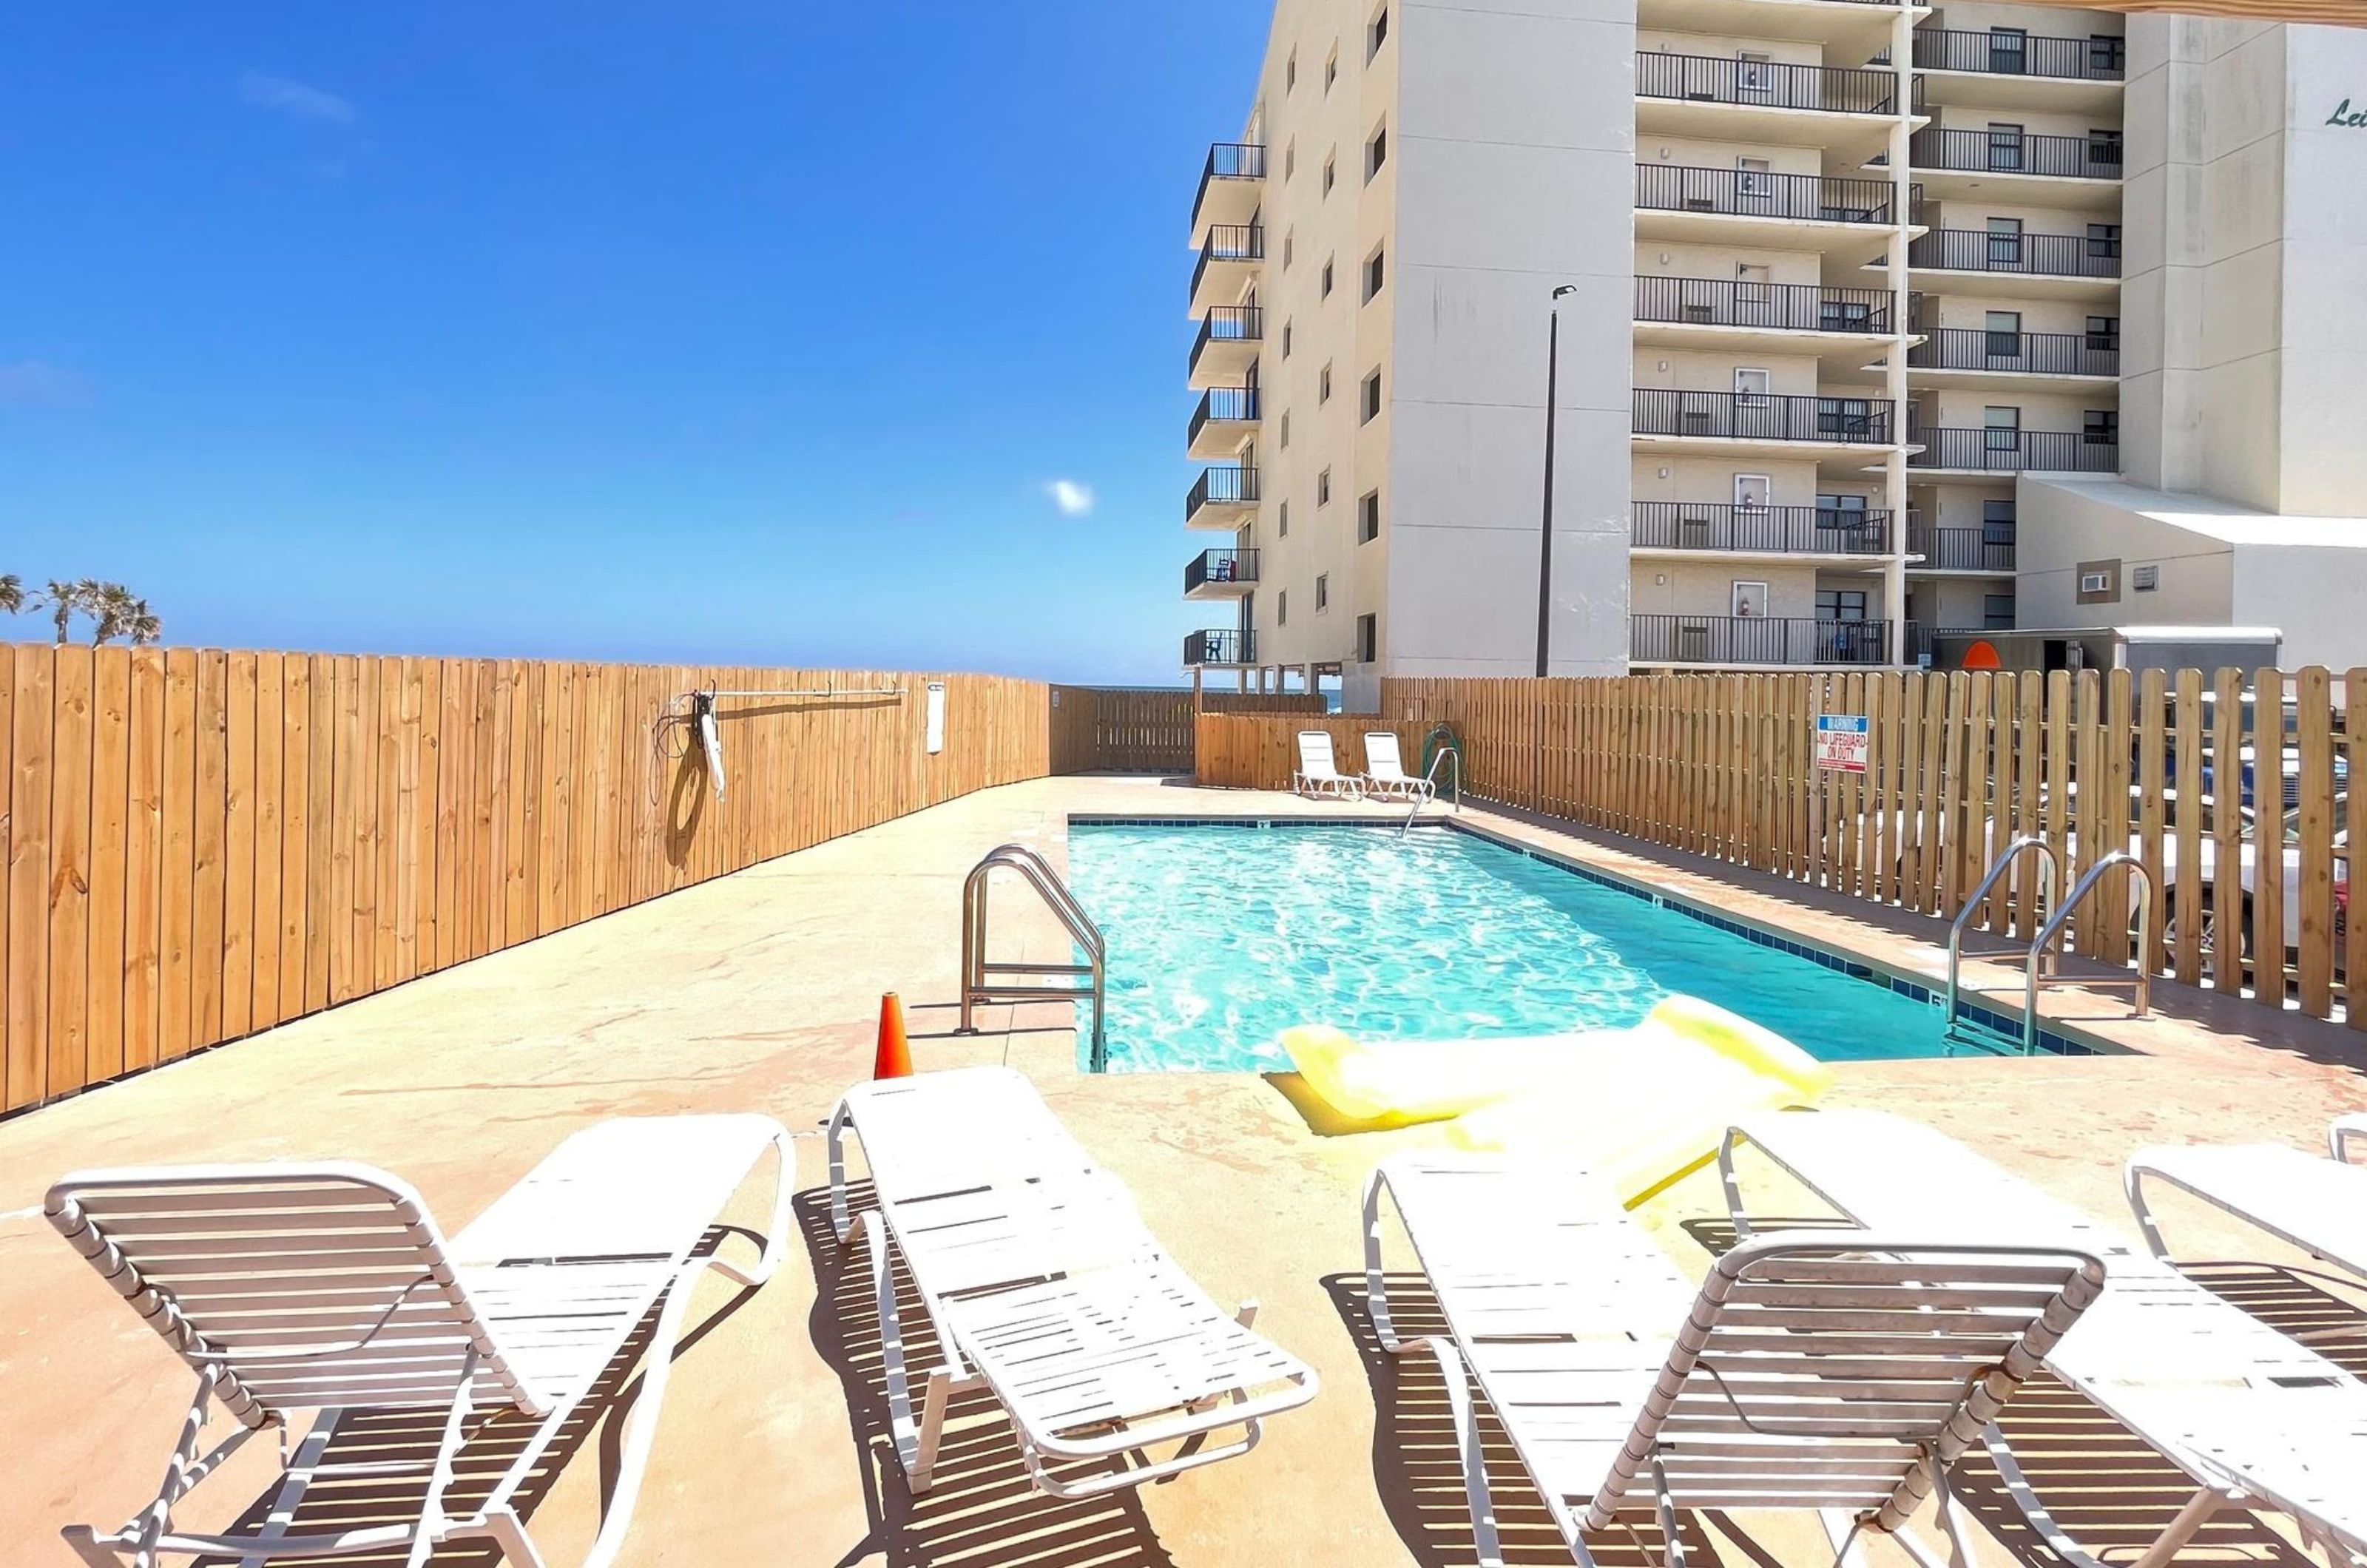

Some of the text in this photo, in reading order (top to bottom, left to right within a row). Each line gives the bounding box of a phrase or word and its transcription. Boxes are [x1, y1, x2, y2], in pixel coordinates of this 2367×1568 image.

[1827, 717, 1858, 731] WARNING
[1820, 732, 1865, 748] NO LIFEGUARD
[1828, 746, 1854, 760] ON DUTY
